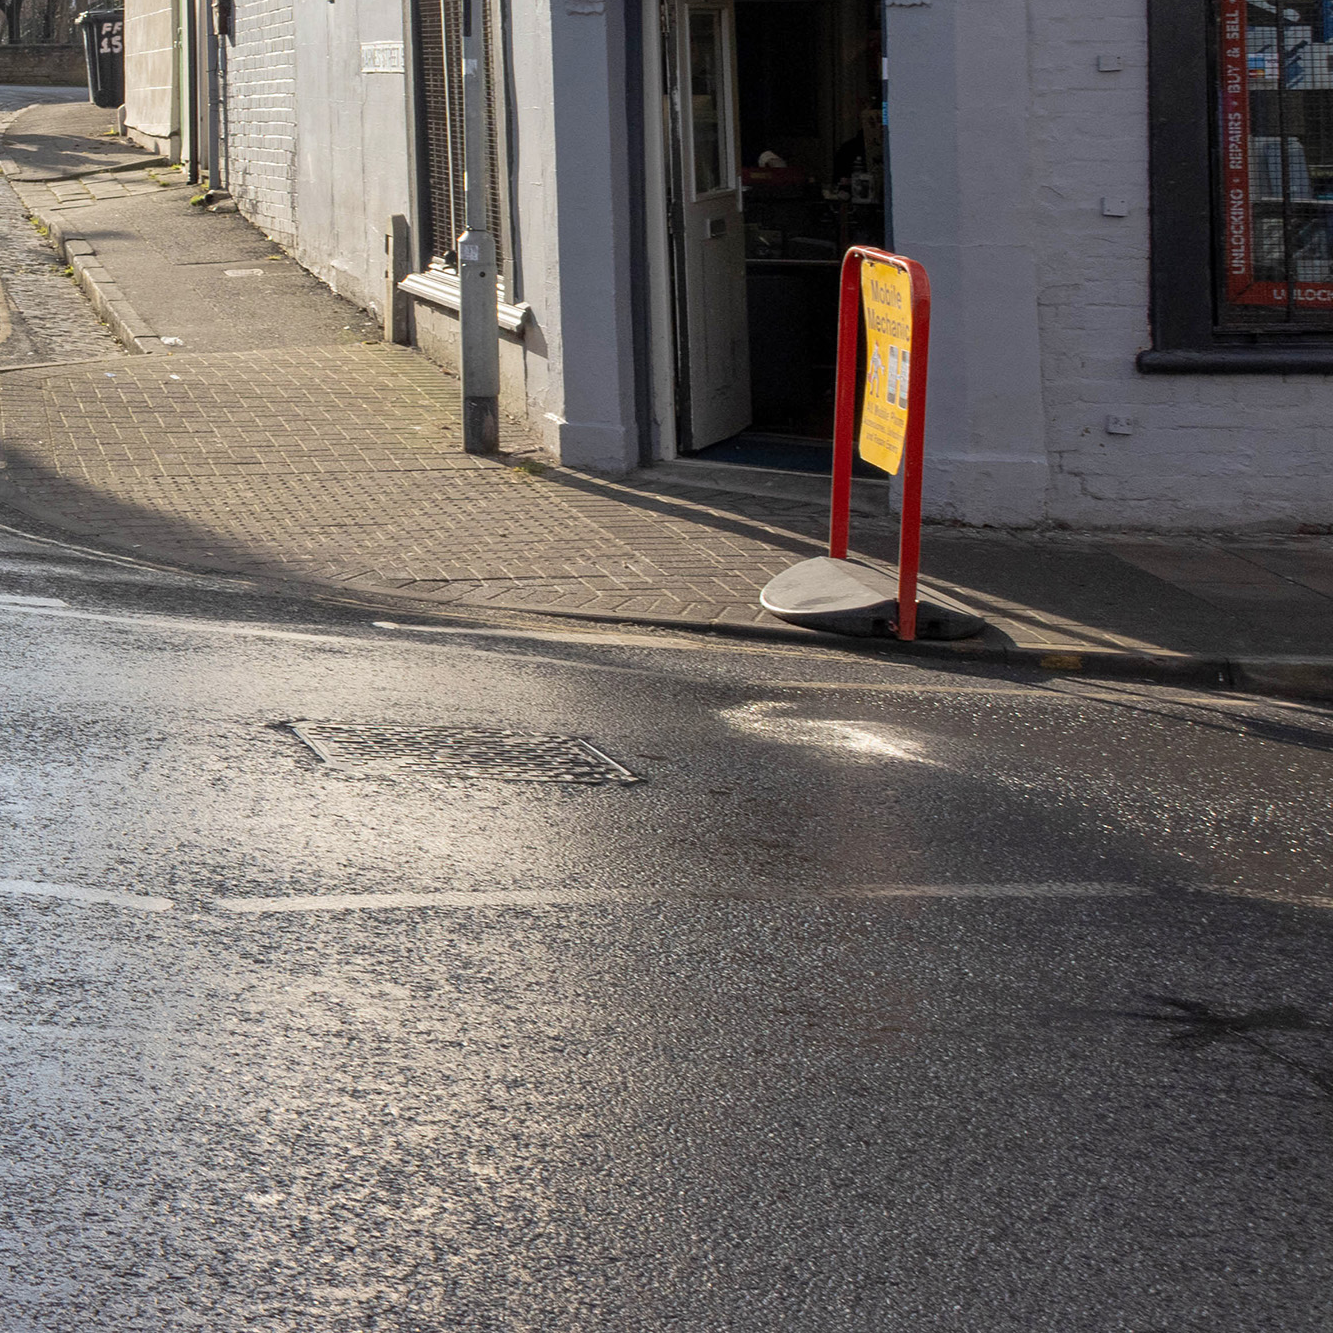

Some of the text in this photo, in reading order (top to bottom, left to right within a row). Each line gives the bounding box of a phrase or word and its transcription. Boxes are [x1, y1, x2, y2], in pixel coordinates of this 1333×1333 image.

[1225, 9, 1240, 39] SELL
[1226, 64, 1241, 93] BUY
[1227, 112, 1242, 170] REPAIRS
[1230, 189, 1246, 274] UNLOCKING
[871, 279, 902, 310] Mobile
[867, 307, 910, 342] Mechanic
